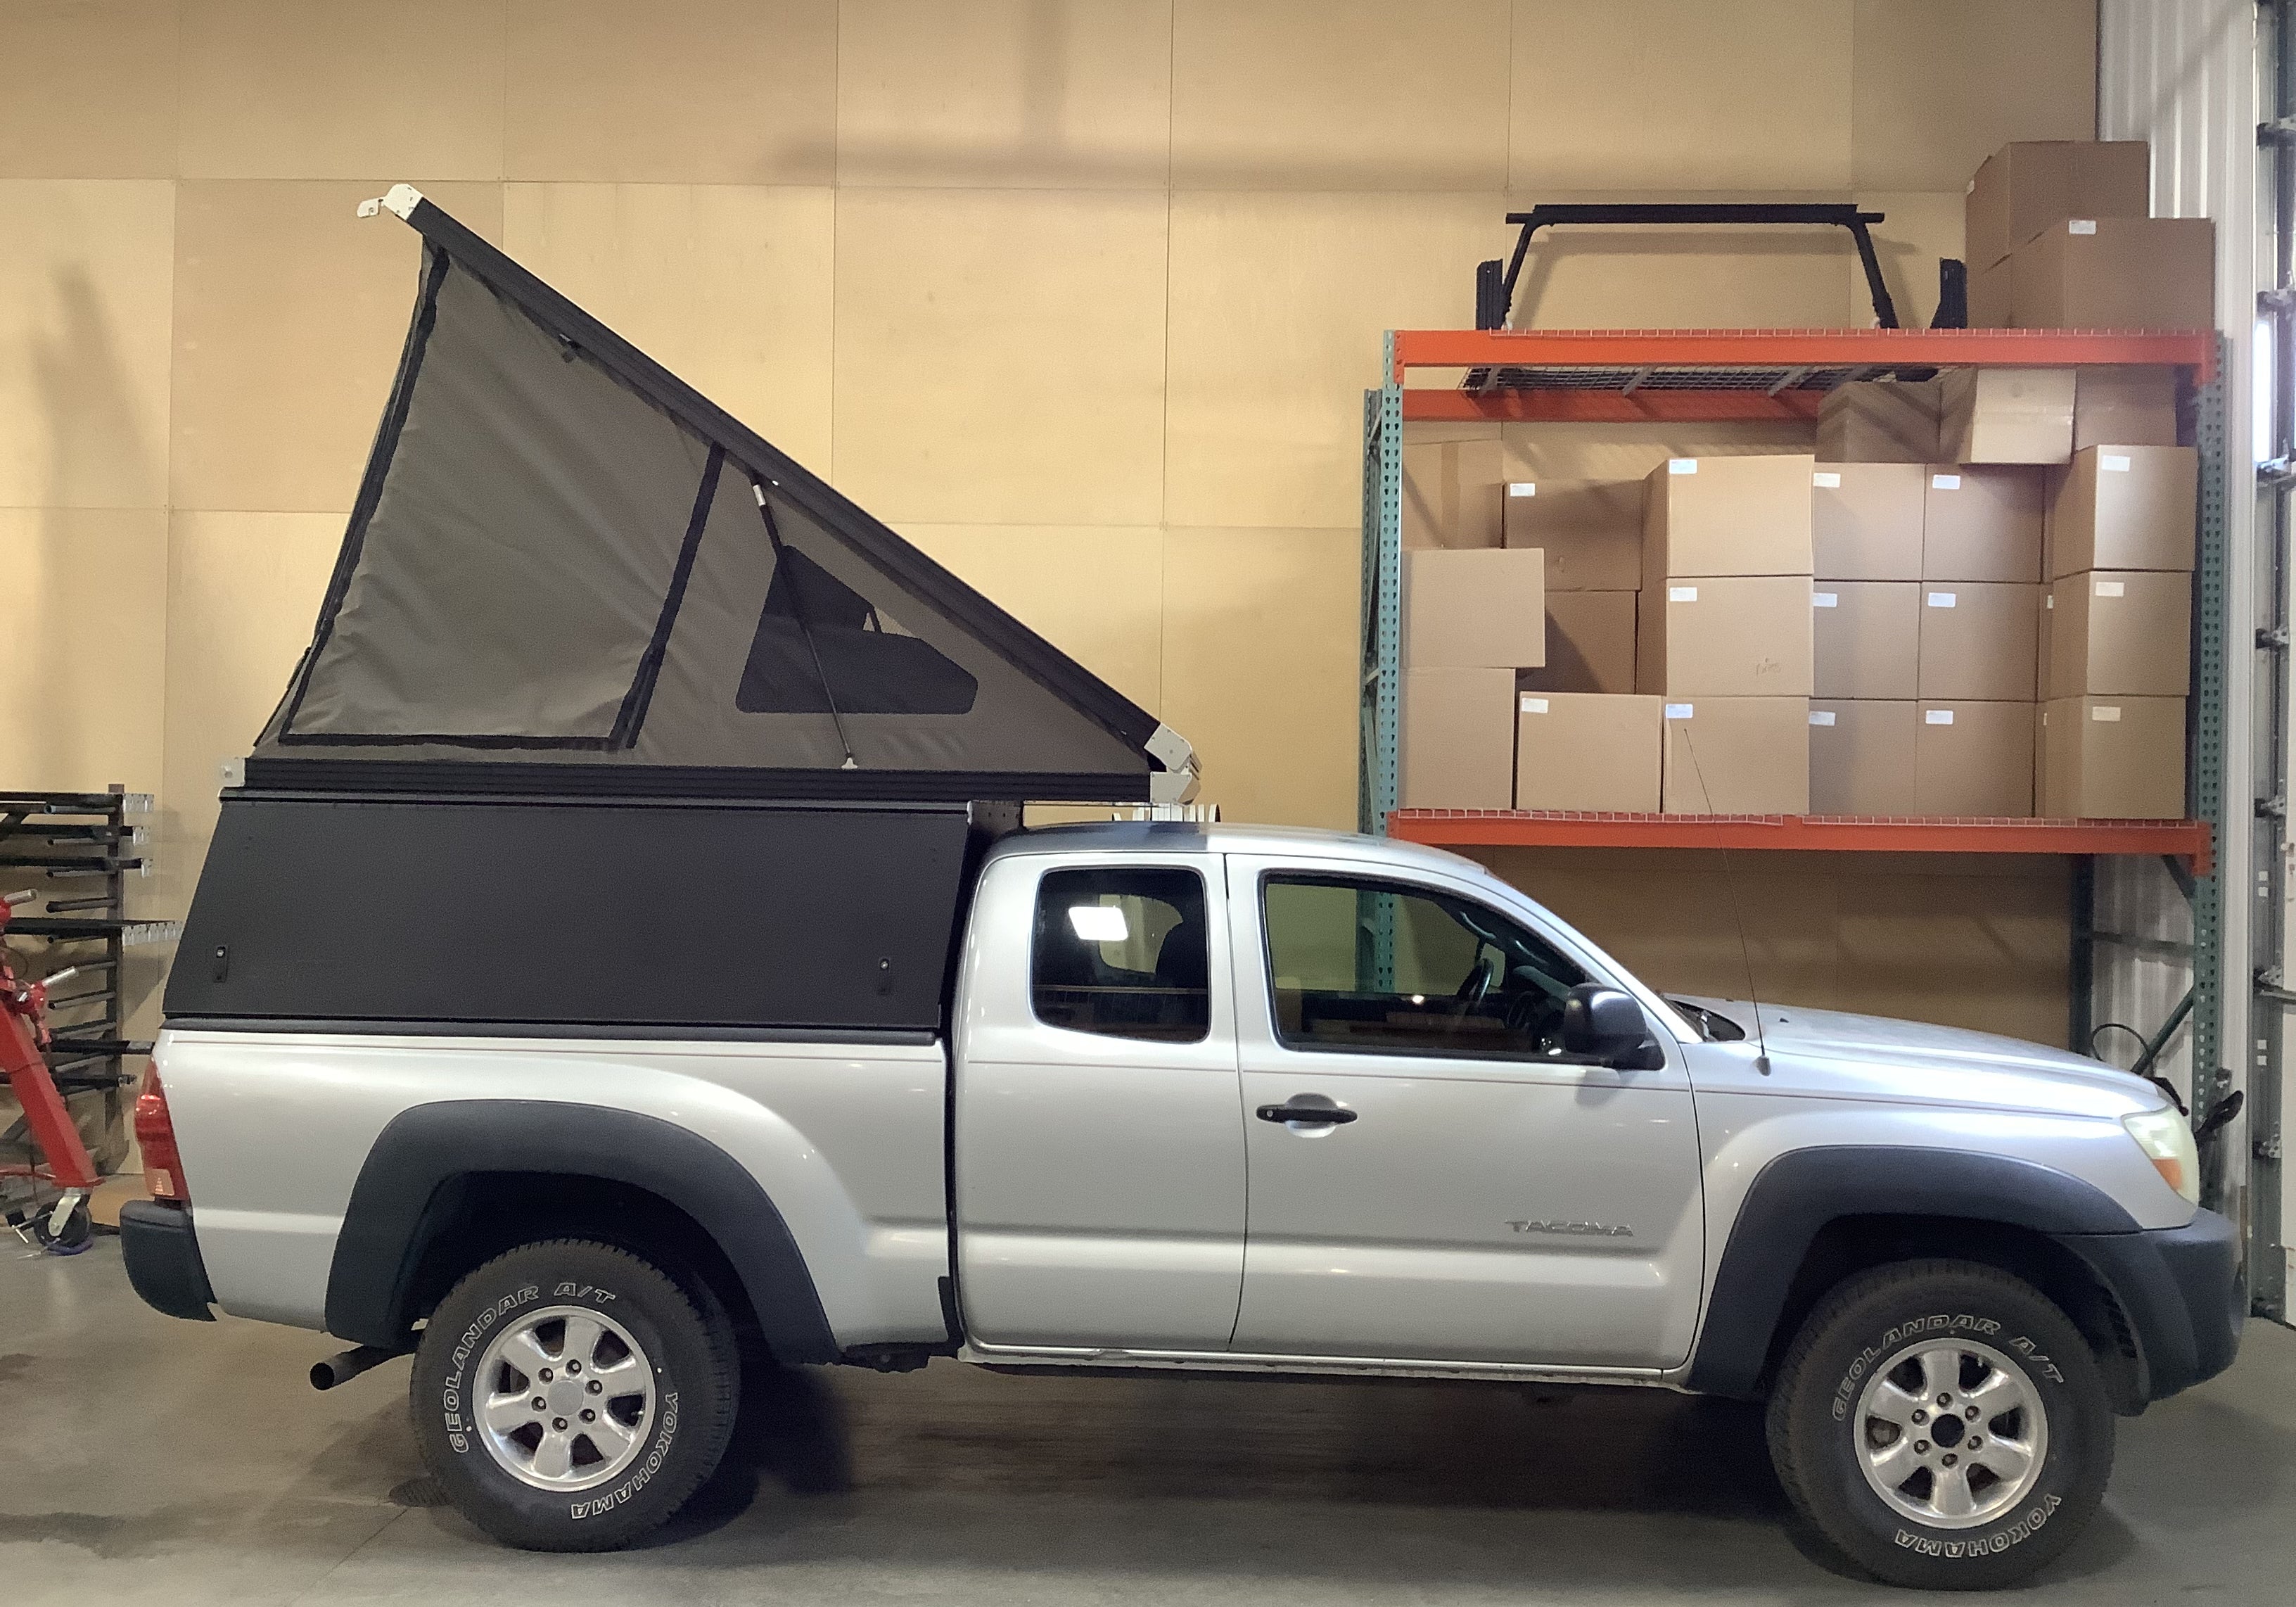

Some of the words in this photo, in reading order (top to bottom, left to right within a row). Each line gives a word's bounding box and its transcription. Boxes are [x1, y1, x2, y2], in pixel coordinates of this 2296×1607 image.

[1505, 1220, 1633, 1236] TACOMA
[444, 1285, 540, 1453] GEOLANDAR
[554, 1283, 616, 1304] A/T
[1832, 1314, 2001, 1421] GEOLANDAR
[2009, 1336, 2065, 1384] A/T
[570, 1392, 679, 1519] YOKOHAMA
[1895, 1494, 2062, 1558] YOKOHAMA
